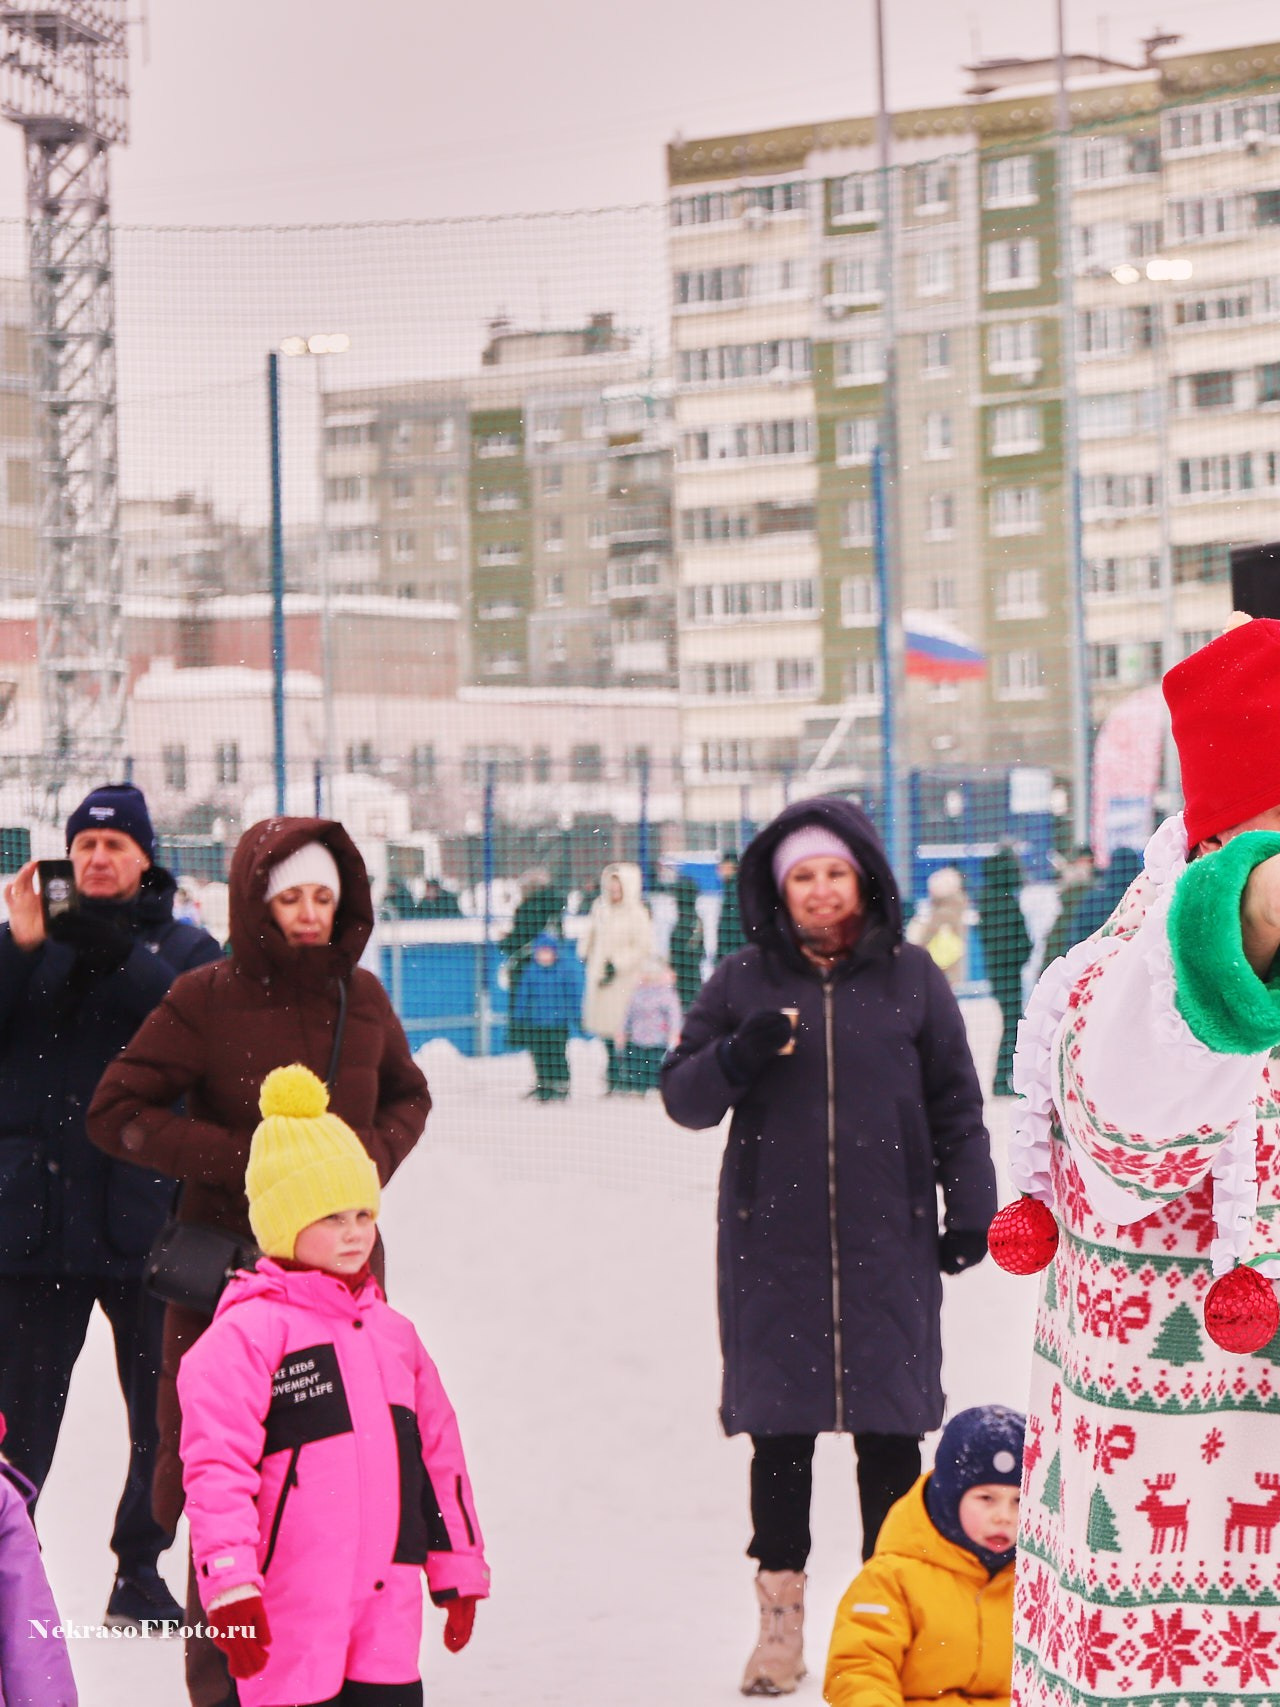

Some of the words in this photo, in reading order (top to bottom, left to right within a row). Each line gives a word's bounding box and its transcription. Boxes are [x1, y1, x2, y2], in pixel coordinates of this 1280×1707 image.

[274, 1368, 286, 1380] KI
[289, 1360, 315, 1376] KIDS
[272, 1372, 320, 1397] OVEMENT
[309, 1382, 333, 1398] LIFE
